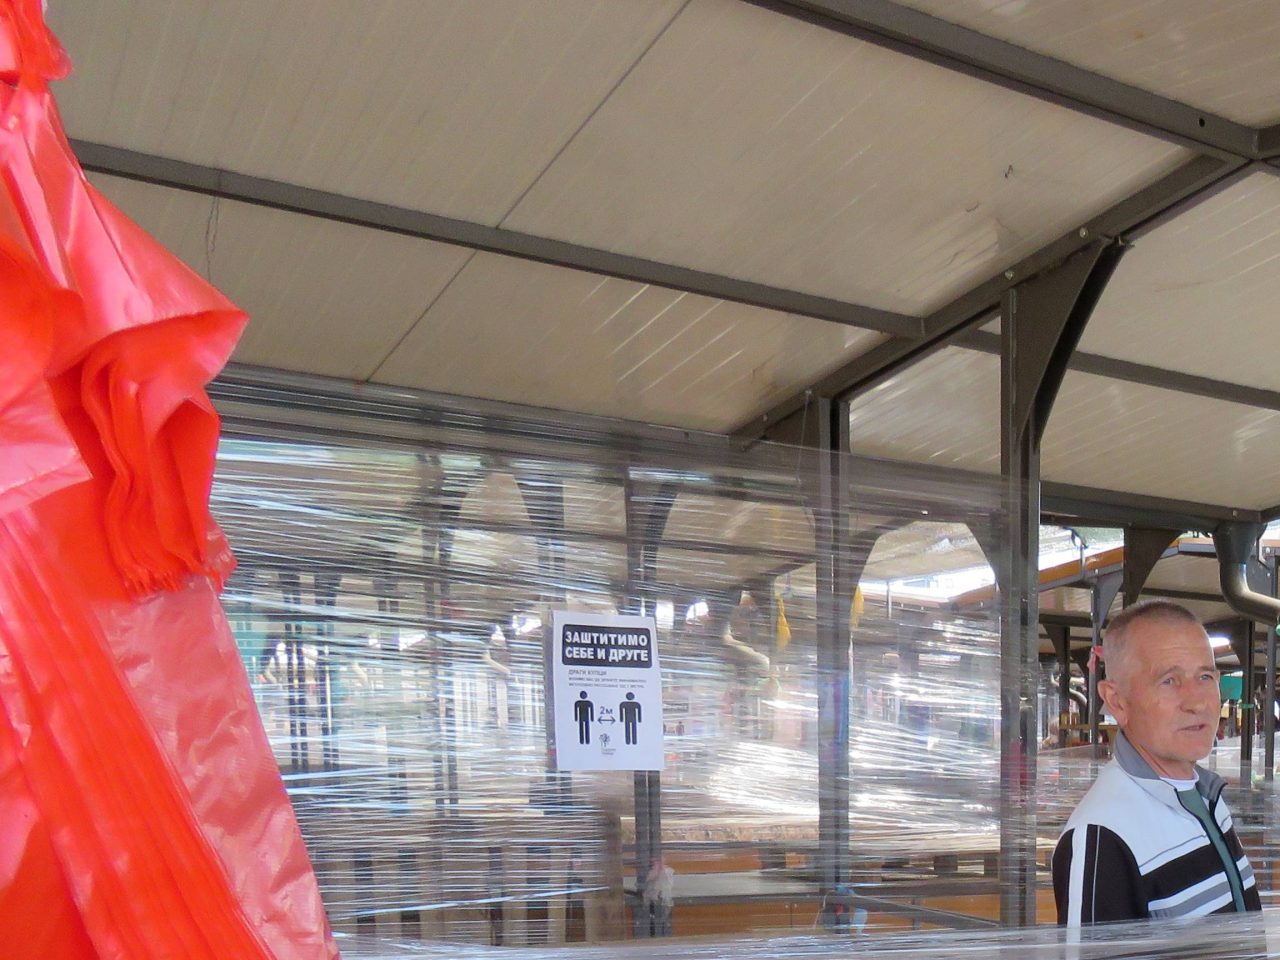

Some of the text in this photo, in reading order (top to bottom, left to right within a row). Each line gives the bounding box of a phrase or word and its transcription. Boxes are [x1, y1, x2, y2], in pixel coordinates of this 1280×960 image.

[565, 631, 648, 646] ЗАШТИТИМО
[565, 646, 649, 662] СЕБЕ И ДРУГЕ
